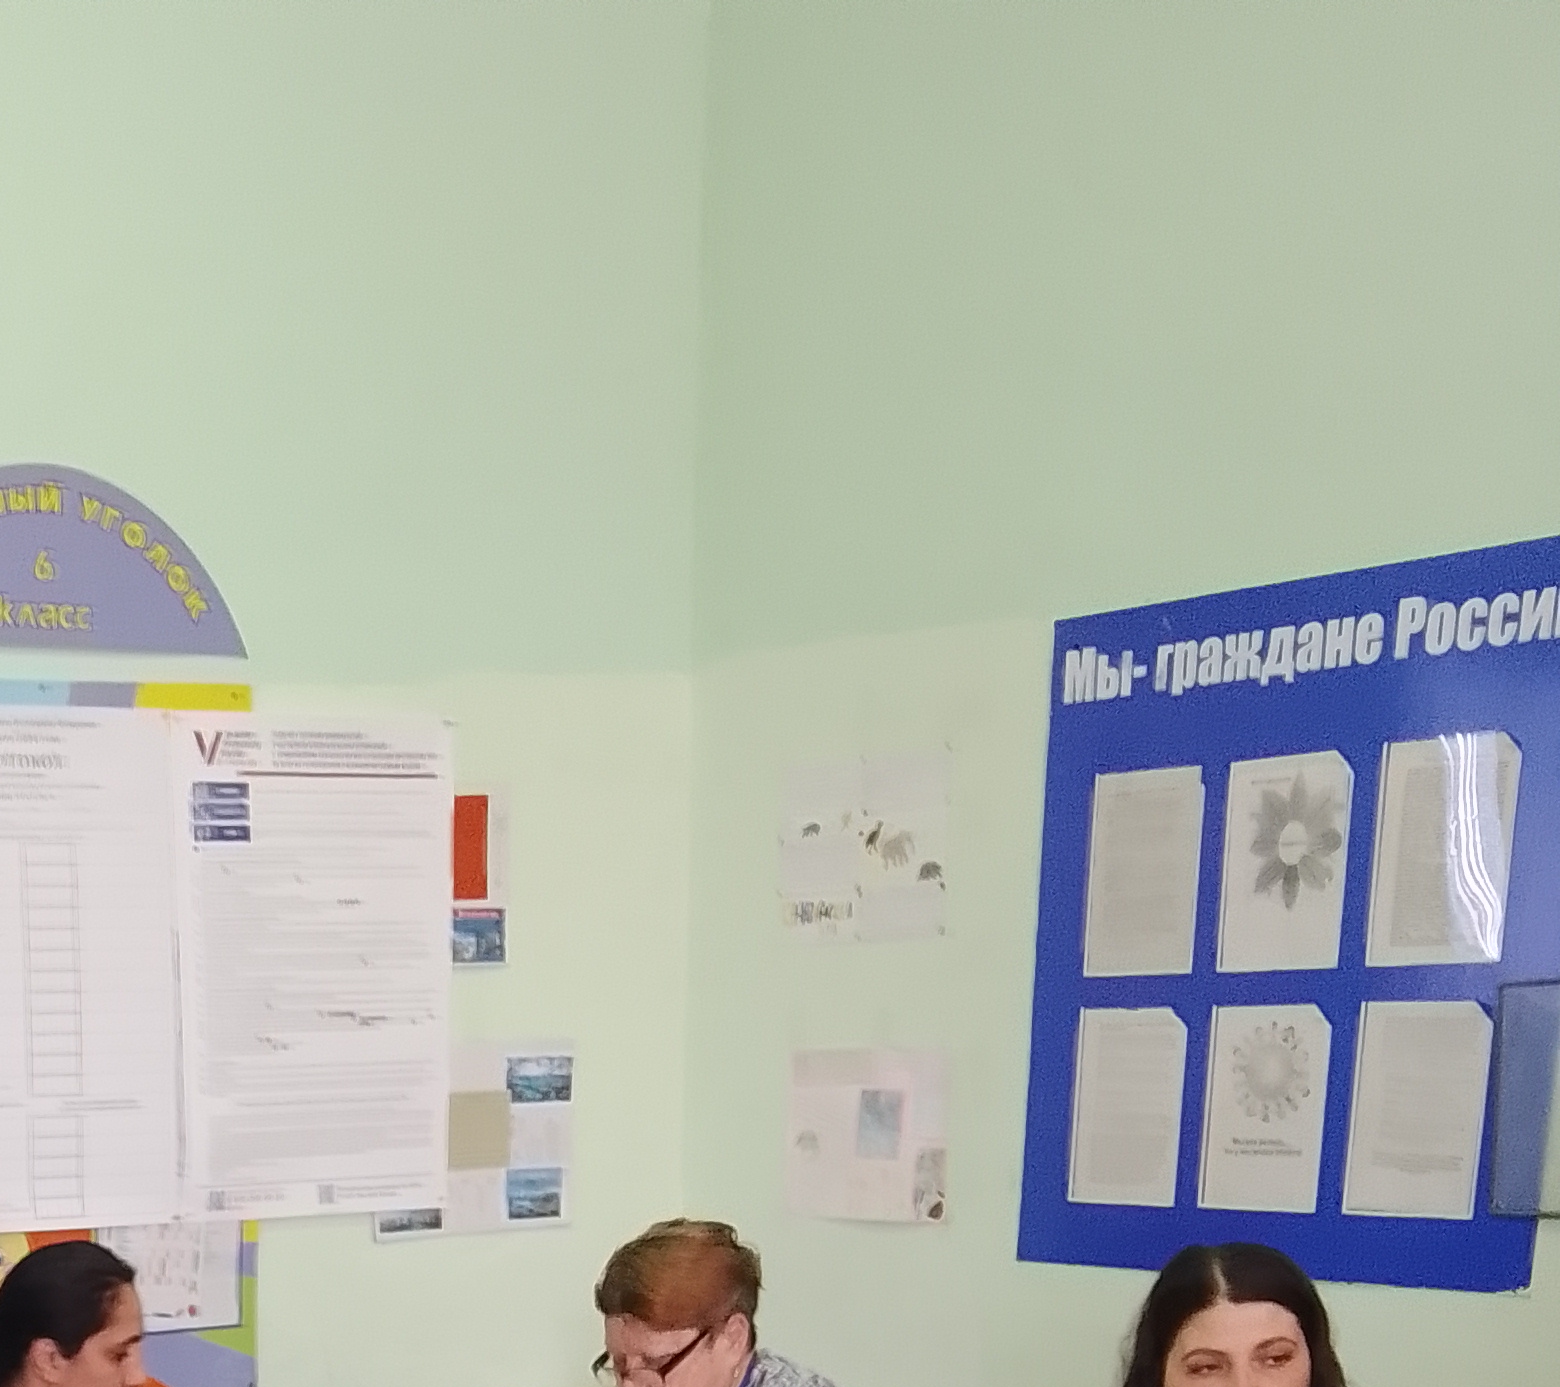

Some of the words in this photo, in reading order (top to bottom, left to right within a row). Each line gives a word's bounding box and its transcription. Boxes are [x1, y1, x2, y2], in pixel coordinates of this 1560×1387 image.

[33, 549, 57, 581] 6
[80, 492, 211, 624] УГОЛОК
[1154, 612, 1385, 696] граждане
[1393, 586, 1560, 660] Росси
